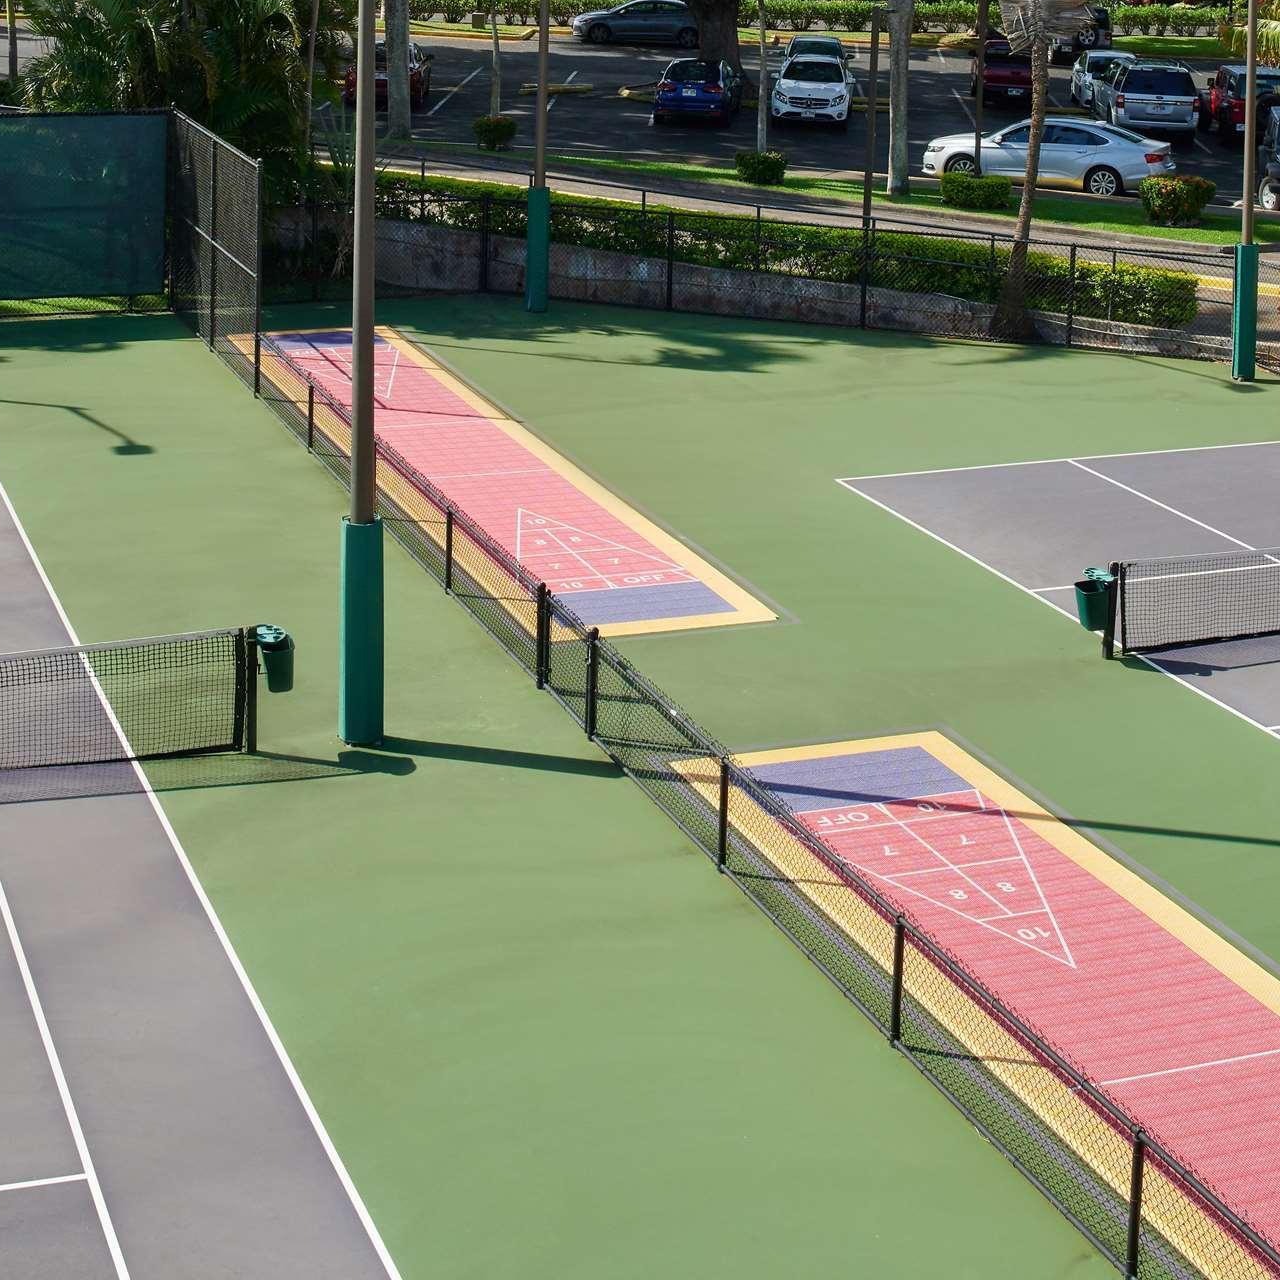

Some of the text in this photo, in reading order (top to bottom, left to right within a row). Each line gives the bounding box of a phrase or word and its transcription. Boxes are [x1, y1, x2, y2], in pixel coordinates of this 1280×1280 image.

[548, 562, 561, 570] 7
[606, 557, 620, 565] 7
[623, 574, 666, 584] OFF
[560, 581, 584, 590] 10
[816, 812, 869, 827] OFF
[960, 834, 977, 846] 7
[883, 845, 900, 857] 7
[996, 882, 1016, 893] 8
[948, 889, 969, 900] 8
[1017, 926, 1051, 940] 10
